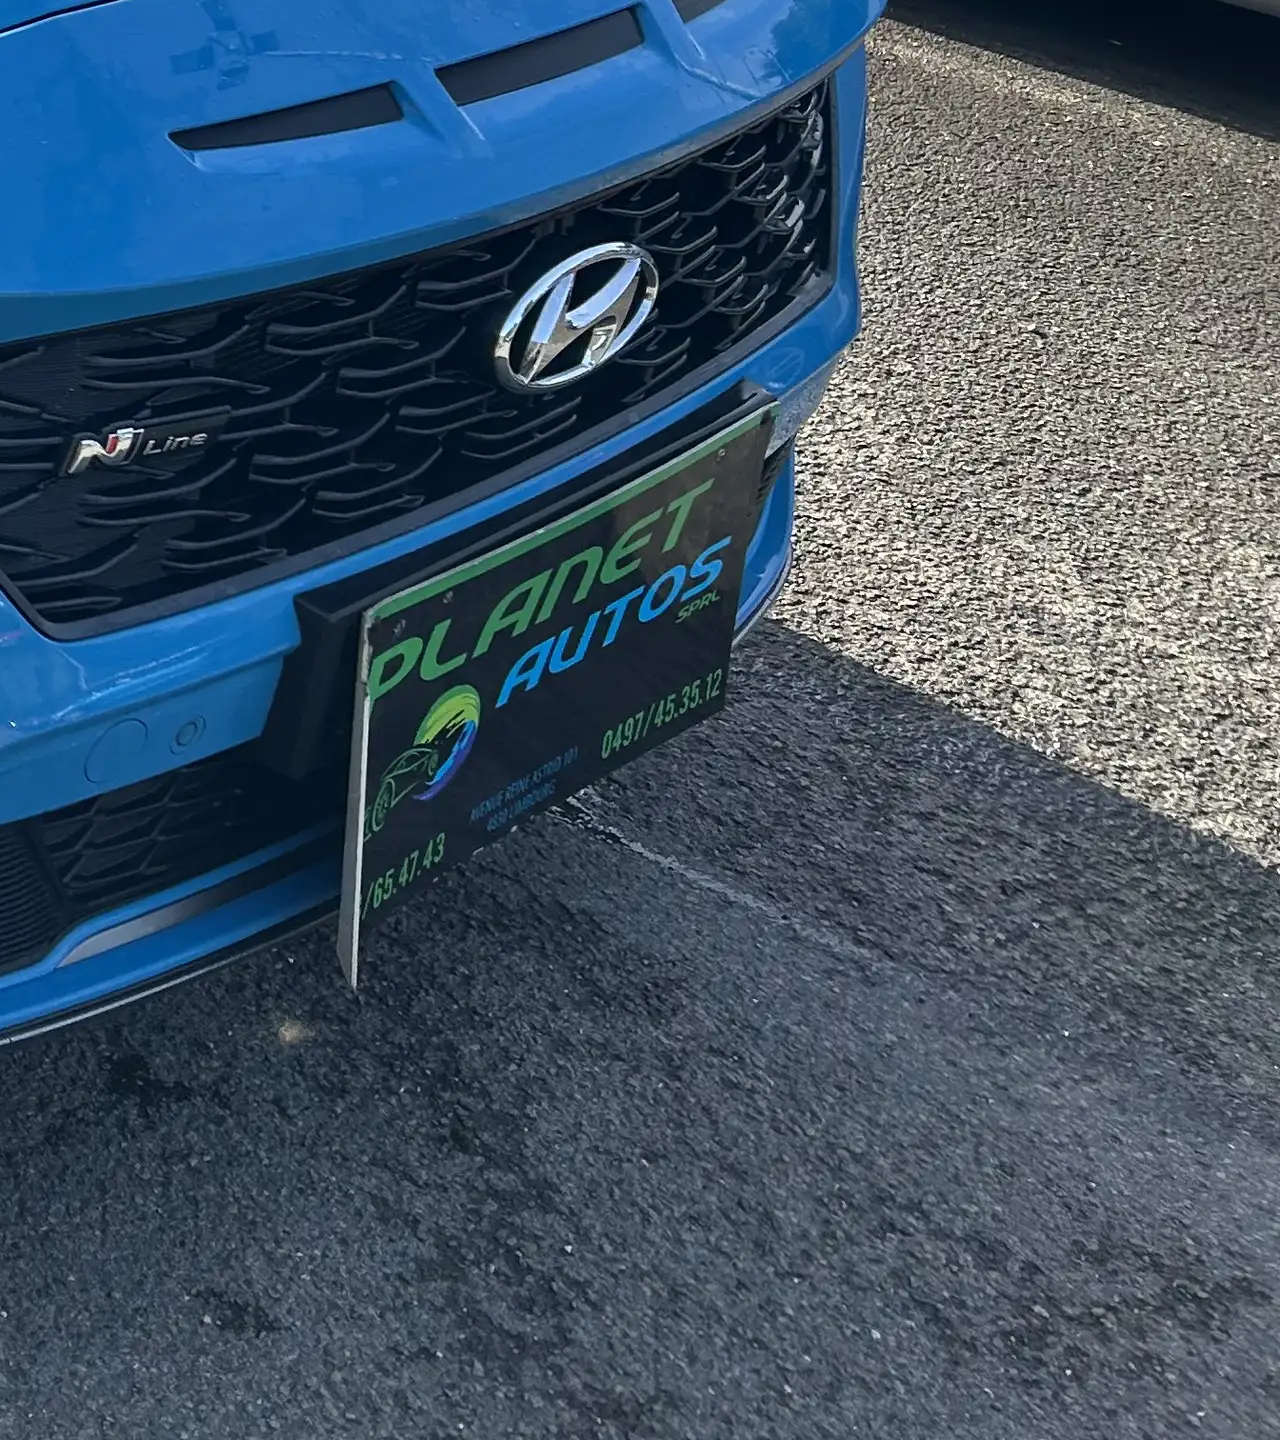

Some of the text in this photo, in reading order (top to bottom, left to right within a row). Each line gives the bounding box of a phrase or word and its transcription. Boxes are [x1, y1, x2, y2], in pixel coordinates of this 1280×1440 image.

[369, 477, 715, 702] PLANET
[495, 535, 732, 710] AUTOS
[674, 589, 722, 624] SPRL
[600, 668, 724, 760] 0497/45.35.12
